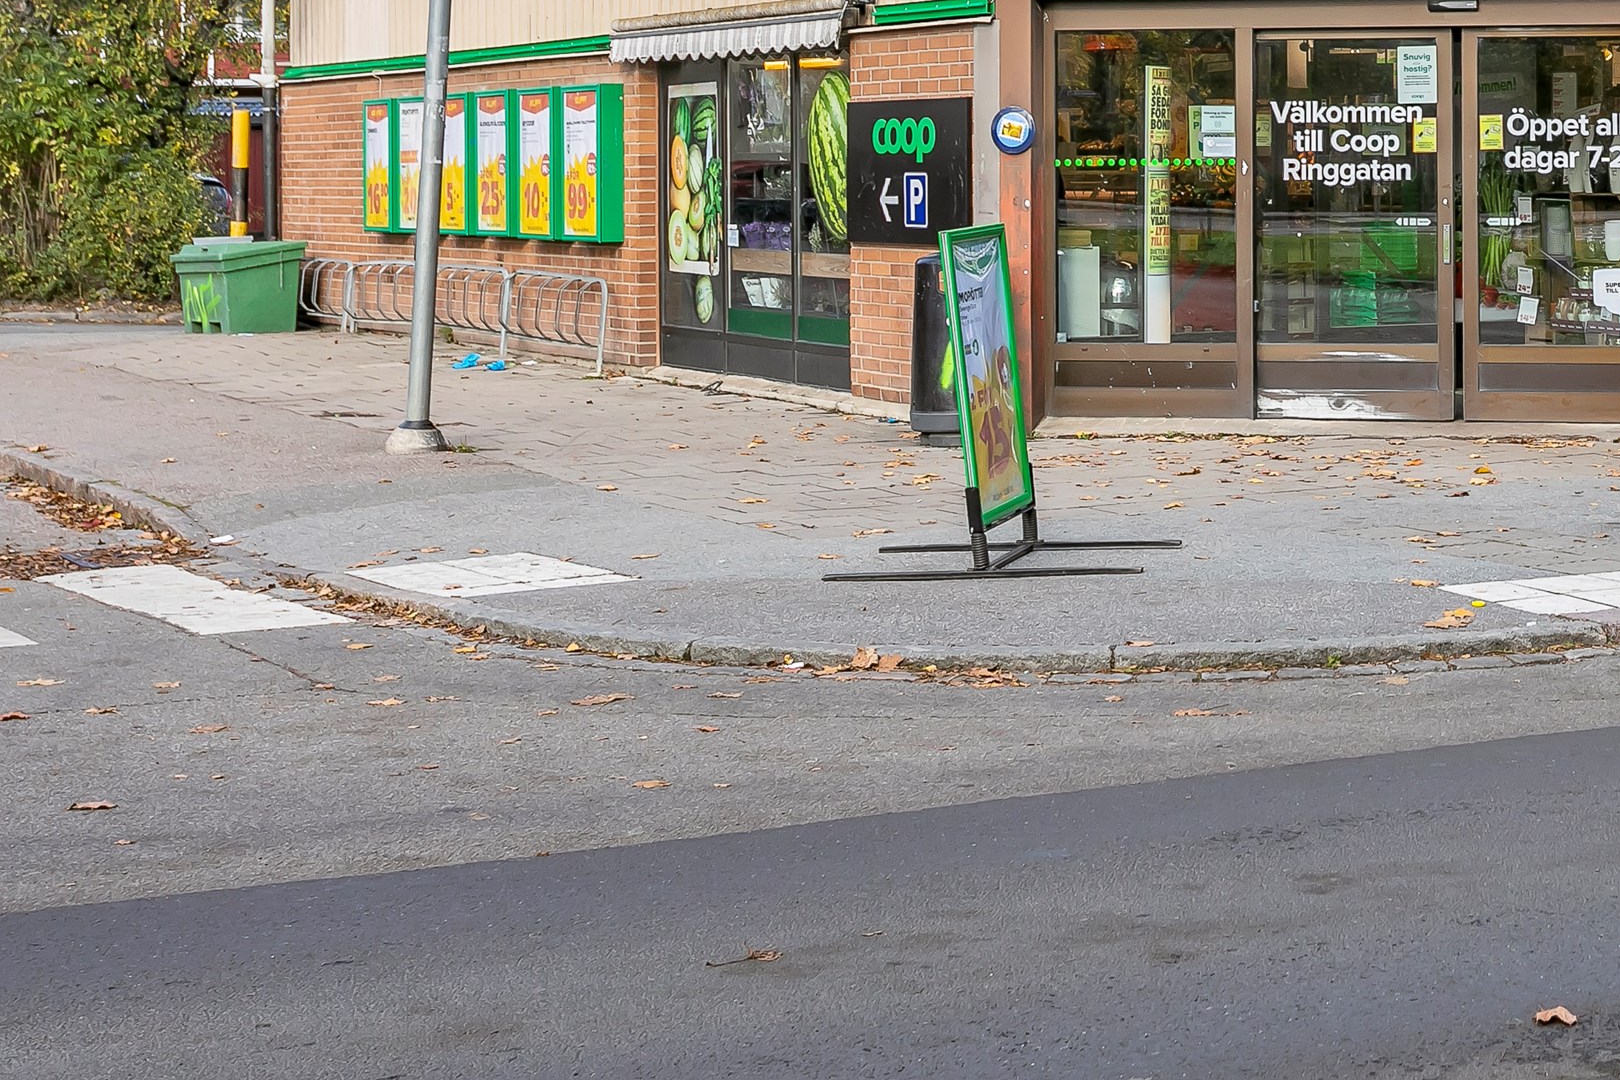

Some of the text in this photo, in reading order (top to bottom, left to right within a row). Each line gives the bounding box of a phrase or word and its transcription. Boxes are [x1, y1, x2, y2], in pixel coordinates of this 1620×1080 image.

[1403, 53, 1431, 62] Snuvig
[1403, 64, 1433, 74] hostig?
[1270, 100, 1423, 124] Välkommen
[1506, 107, 1590, 142] Öppet
[872, 116, 937, 164] coop
[1293, 129, 1401, 158] till Coop
[1282, 157, 1412, 188] Ringgatan
[1504, 145, 1580, 175] dagar
[481, 180, 500, 215] 25
[524, 182, 540, 219] 10
[568, 183, 588, 220] 99
[909, 181, 924, 222] P
